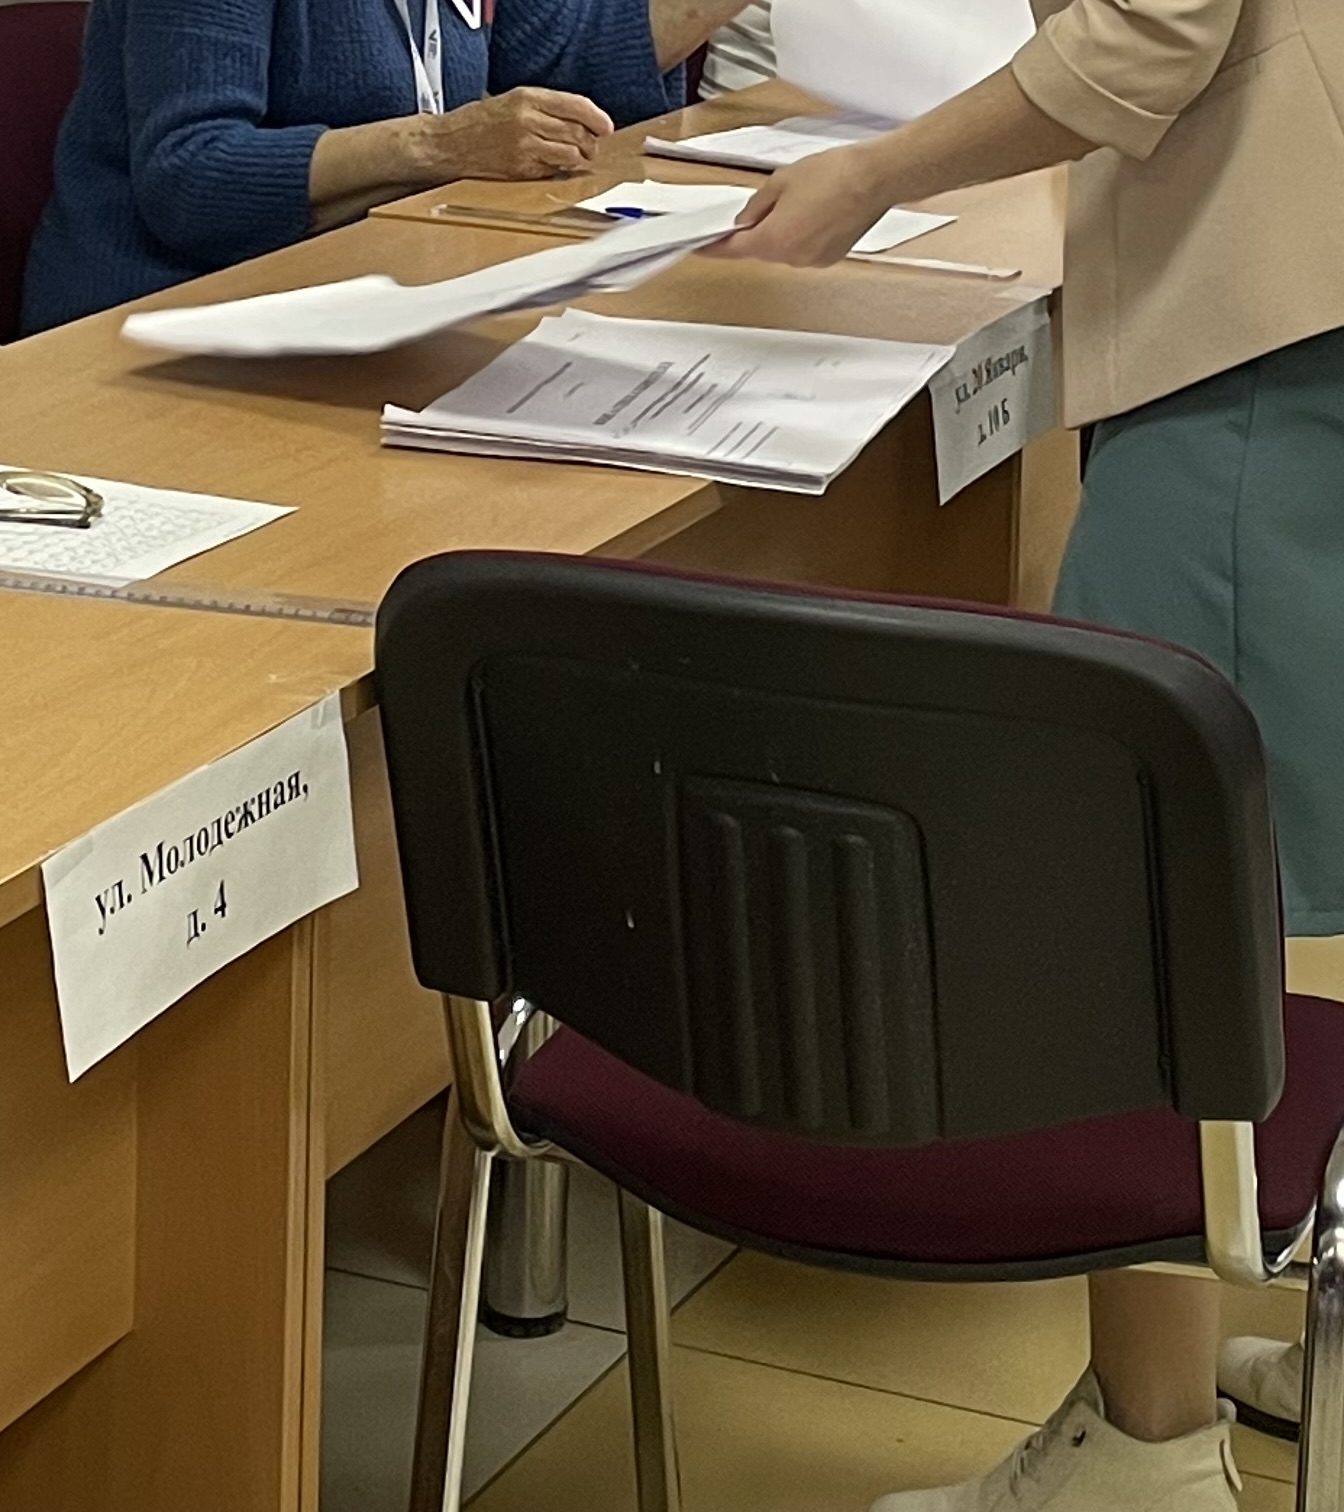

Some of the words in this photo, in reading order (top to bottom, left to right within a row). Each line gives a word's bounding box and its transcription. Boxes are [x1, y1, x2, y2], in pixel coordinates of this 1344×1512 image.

[94, 878, 133, 936] ул.
[139, 769, 310, 896] Молодежная,
[185, 908, 207, 949] д.
[213, 878, 228, 919] 4
